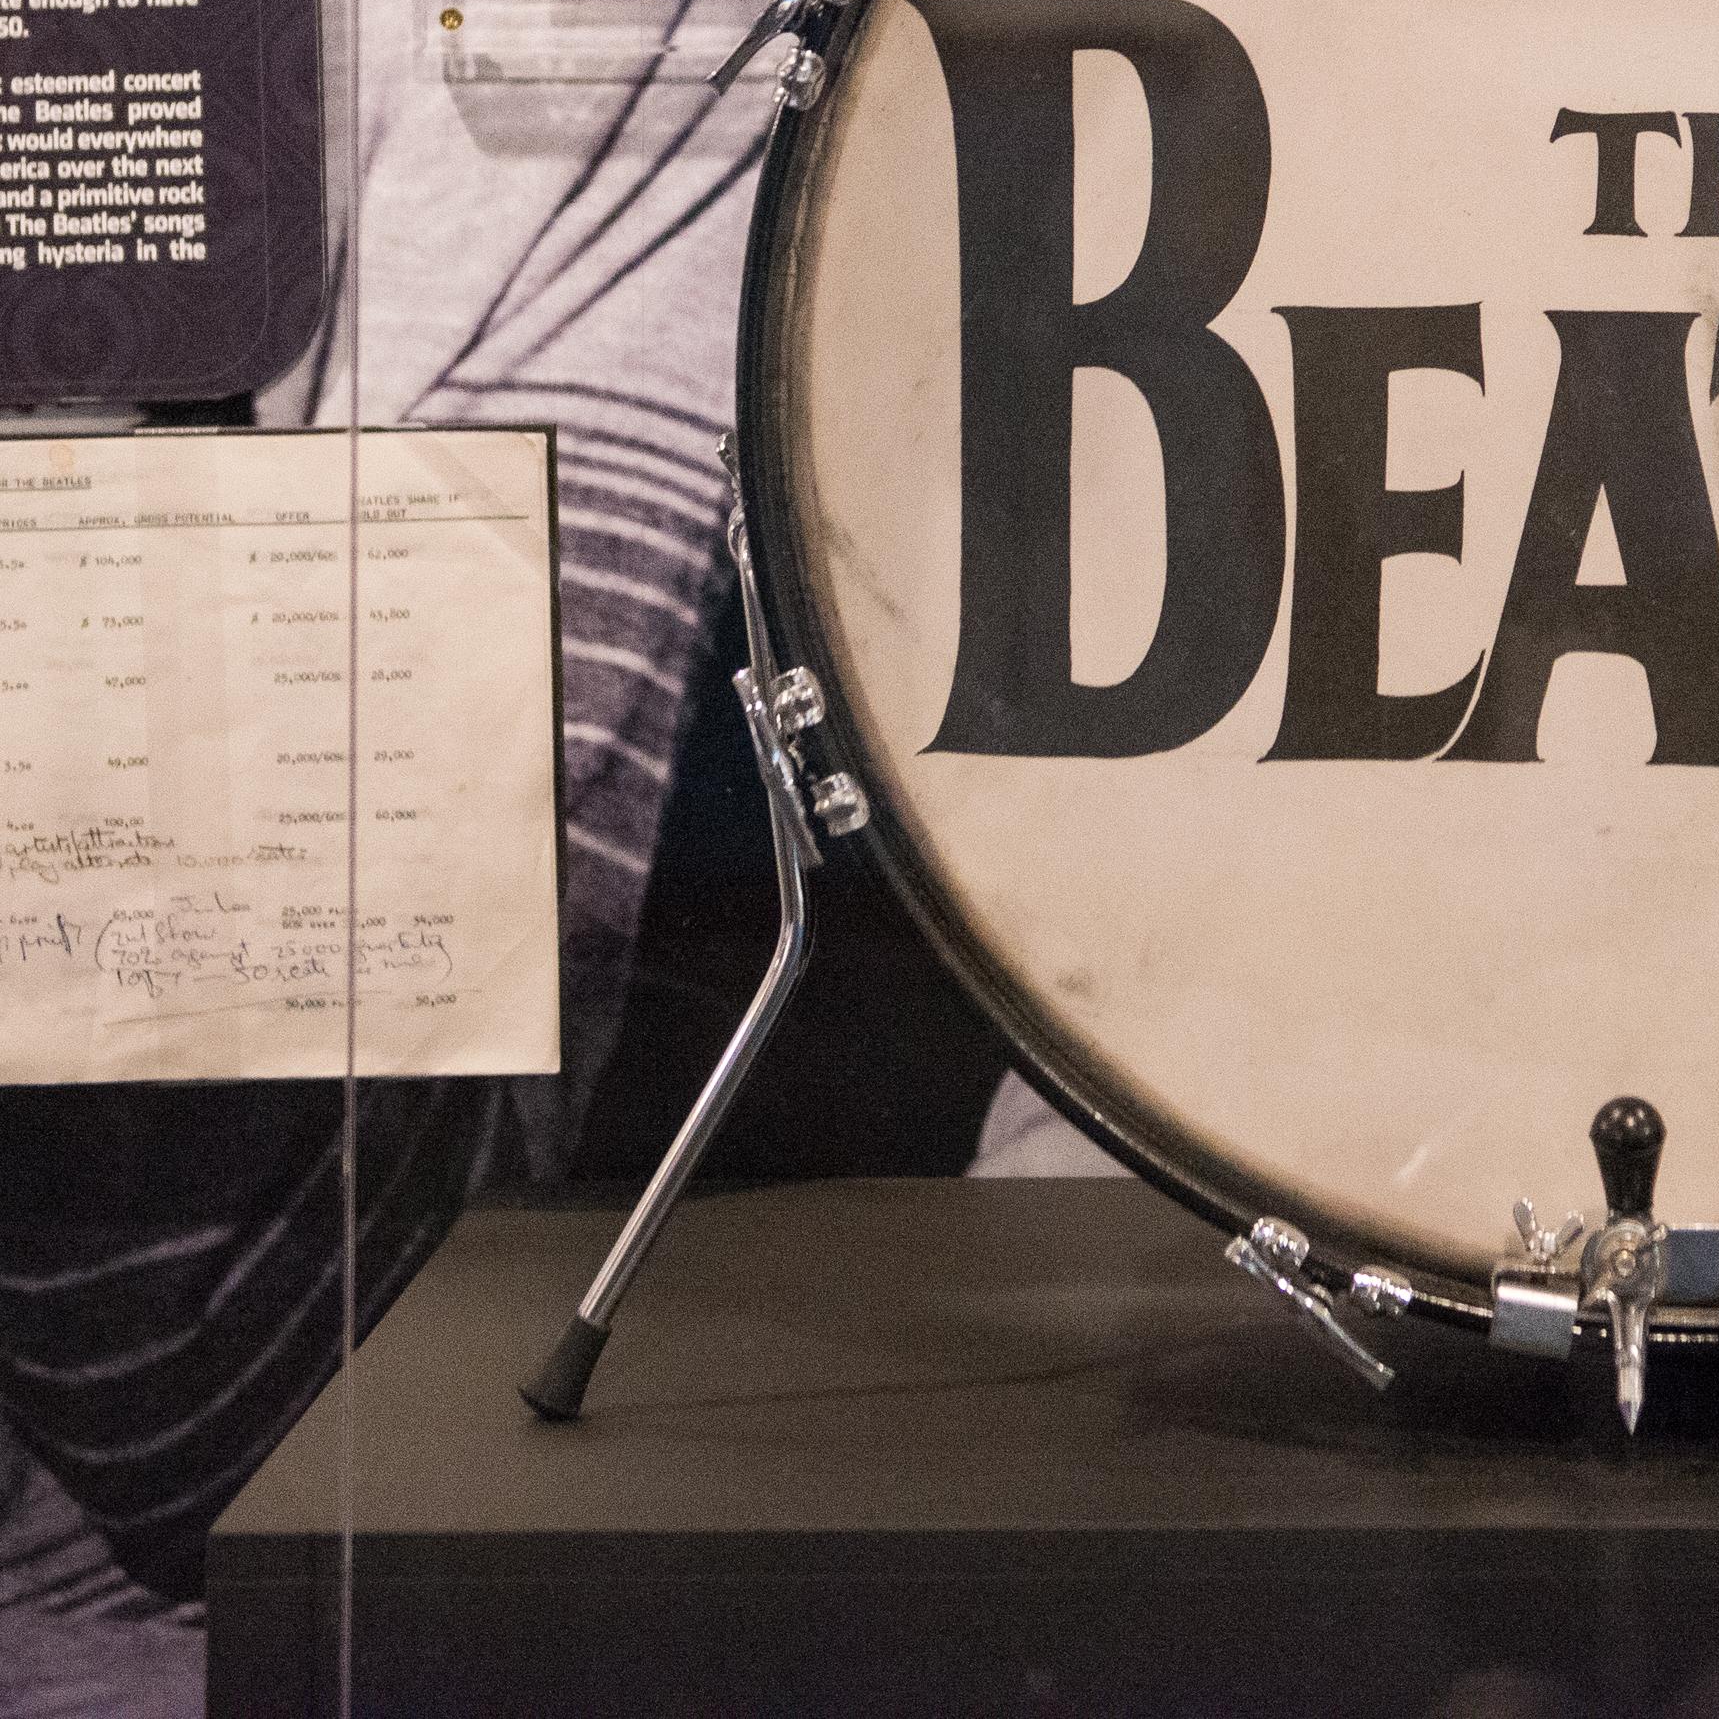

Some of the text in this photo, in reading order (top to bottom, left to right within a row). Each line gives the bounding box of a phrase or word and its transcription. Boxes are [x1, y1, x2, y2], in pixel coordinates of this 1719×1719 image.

[11, 70, 201, 93] esteemed concert
[38, 237, 206, 267] hysteria in the
